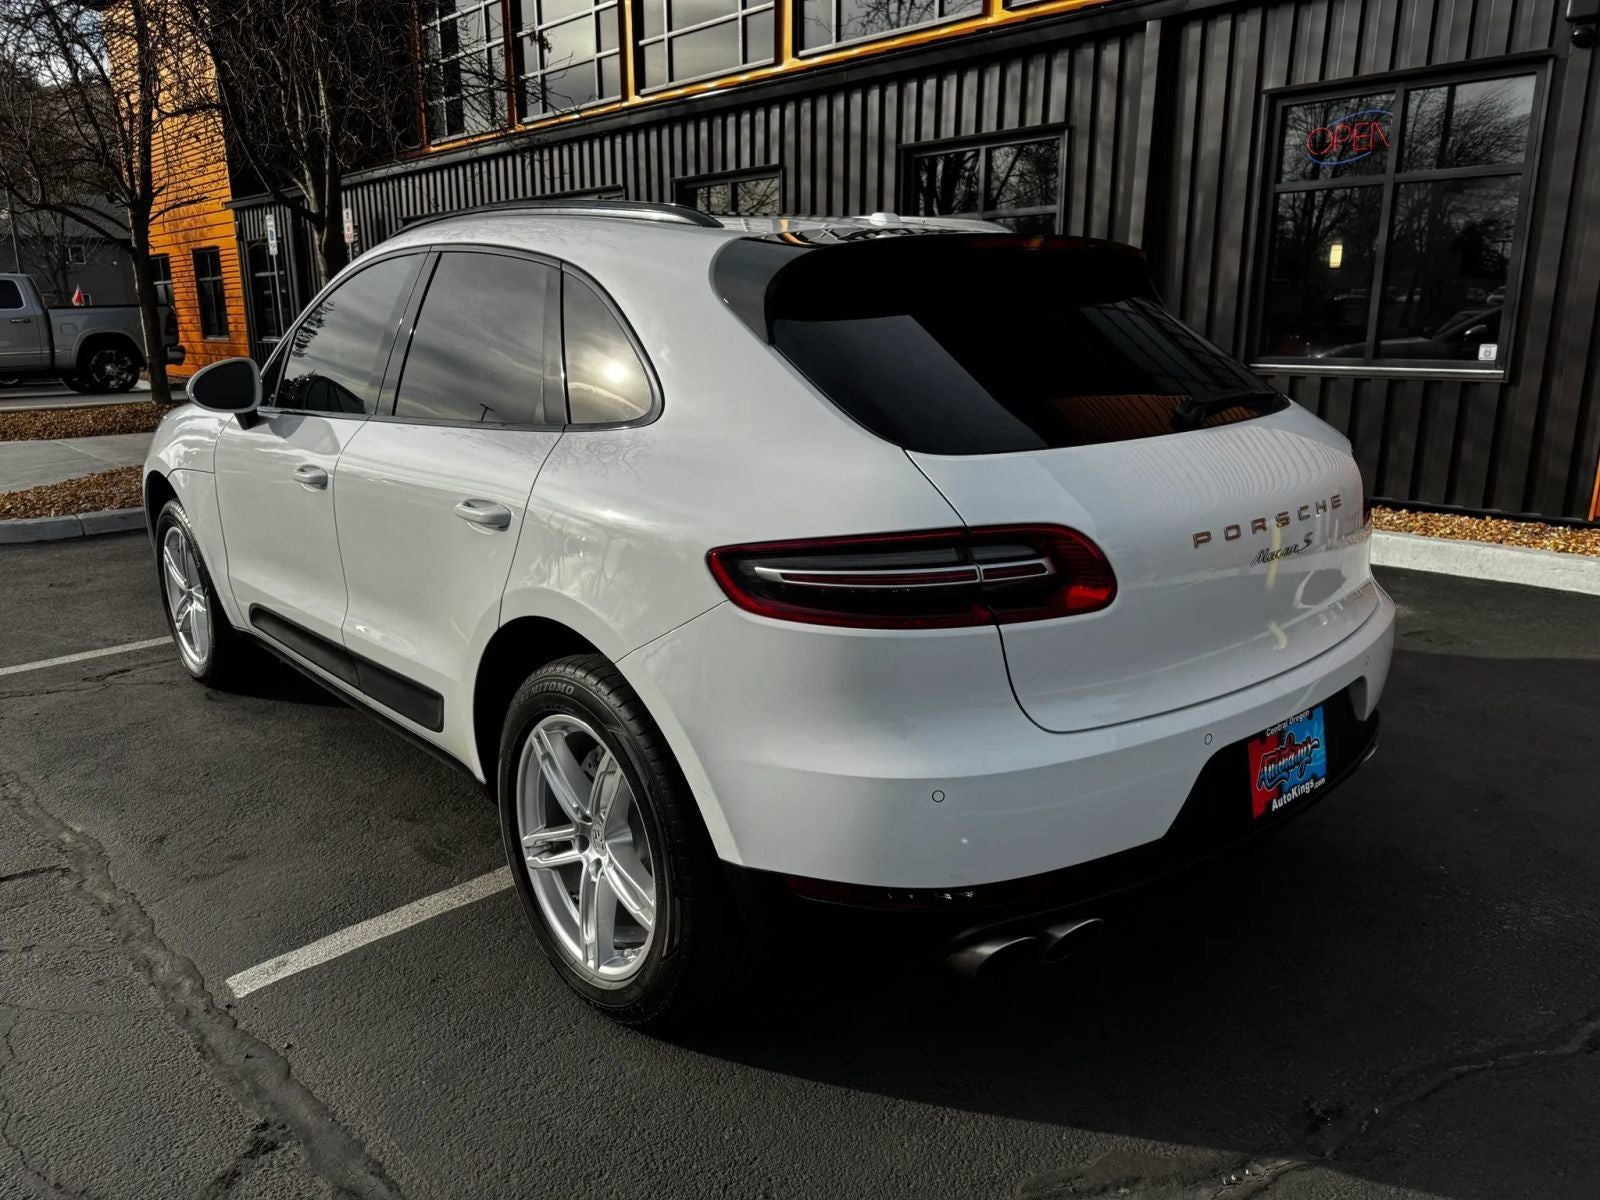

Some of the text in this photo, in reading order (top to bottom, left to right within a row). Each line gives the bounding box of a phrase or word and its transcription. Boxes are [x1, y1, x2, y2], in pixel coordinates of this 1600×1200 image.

[1306, 121, 1392, 155] OPEN
[1192, 494, 1343, 549] PORSCHE
[1250, 531, 1314, 568] Macan S
[1266, 719, 1288, 737] Central
[1271, 777, 1326, 812] AutoKings.com
